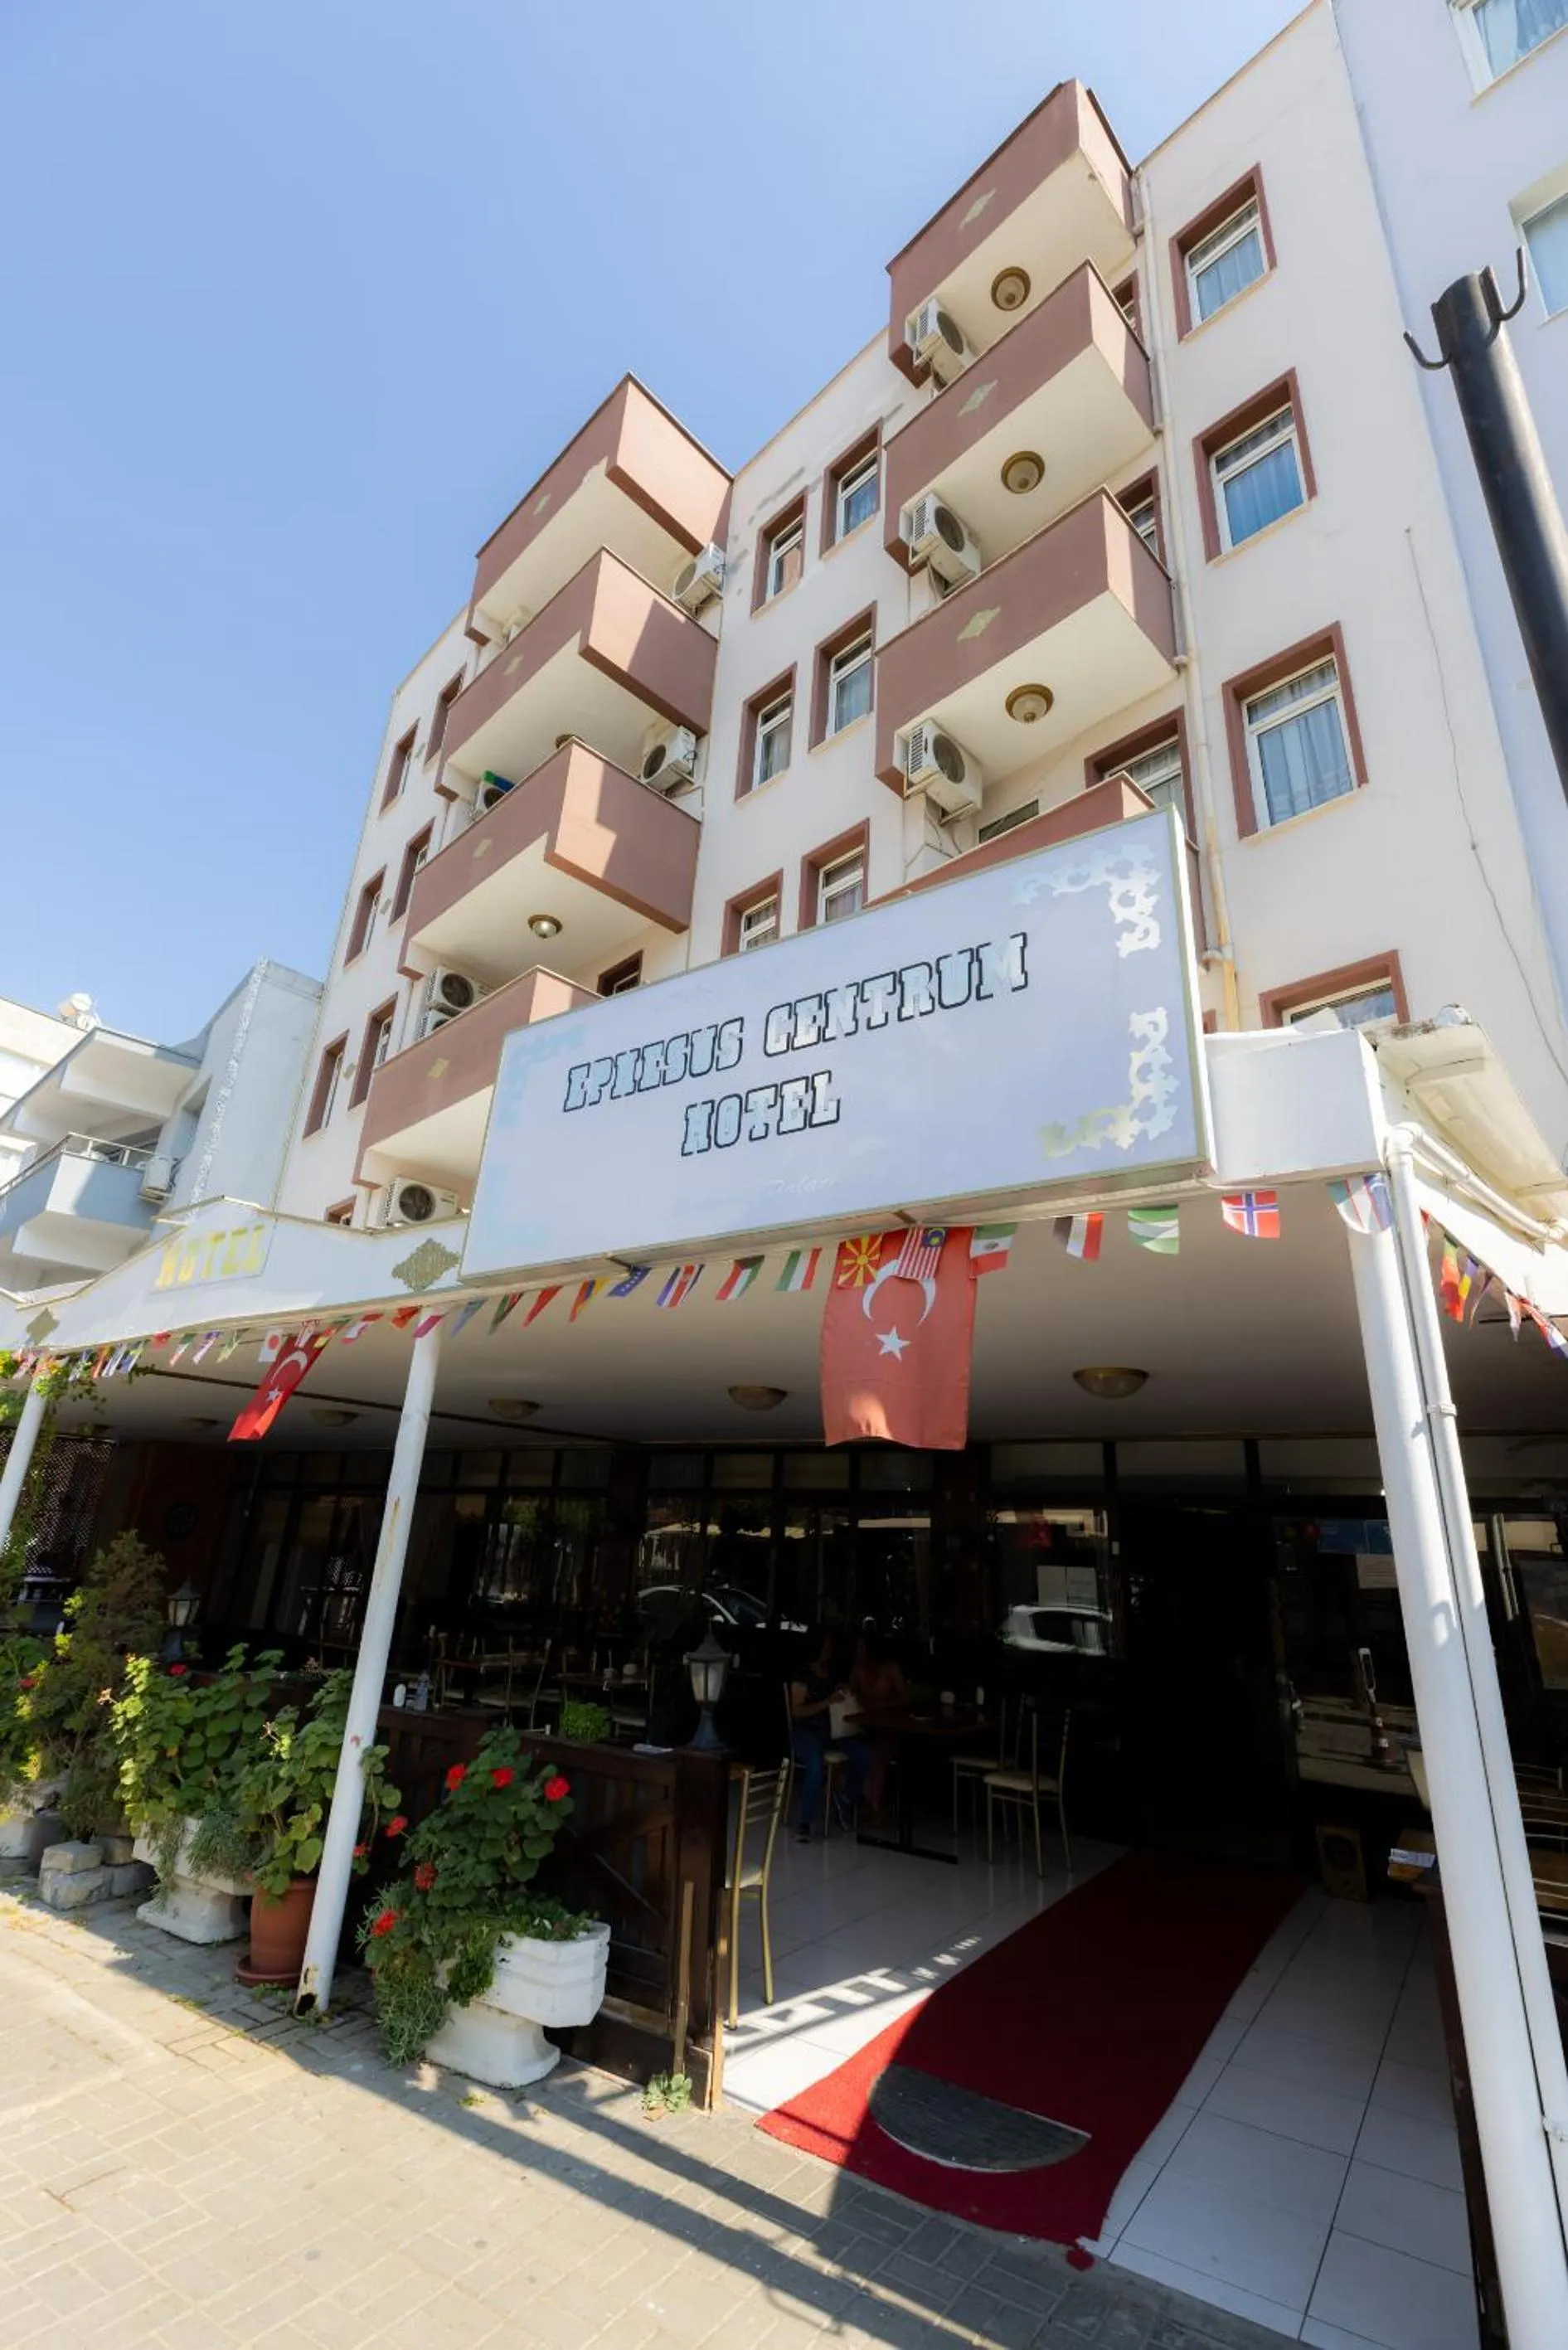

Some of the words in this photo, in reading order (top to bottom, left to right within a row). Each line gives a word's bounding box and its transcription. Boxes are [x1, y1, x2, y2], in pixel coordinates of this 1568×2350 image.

[564, 1017, 745, 1111] EPHESUS
[764, 932, 1027, 1057] CENTRUM
[681, 1071, 840, 1157] HOTEL
